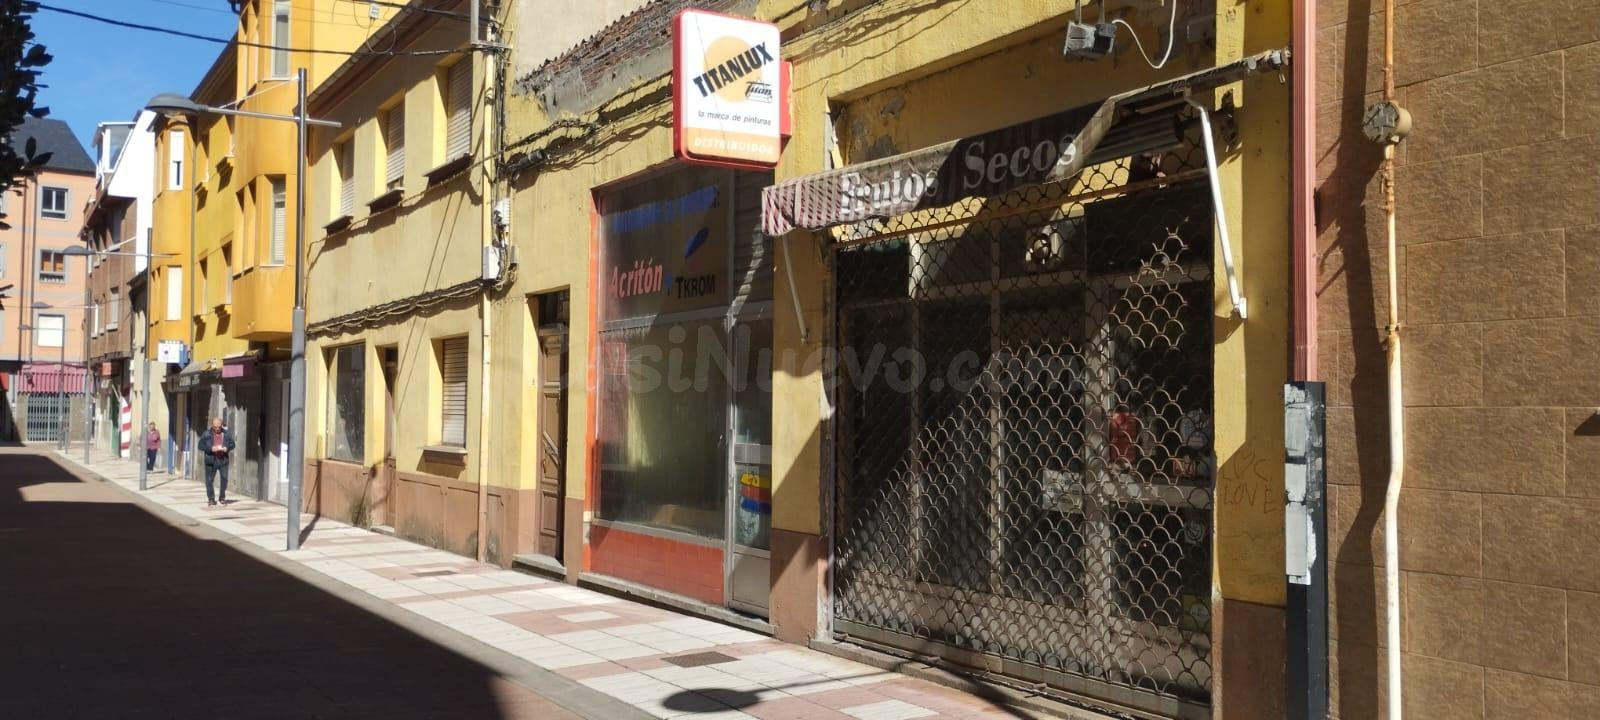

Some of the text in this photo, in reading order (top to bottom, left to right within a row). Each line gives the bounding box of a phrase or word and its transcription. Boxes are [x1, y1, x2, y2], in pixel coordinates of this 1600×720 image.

[693, 42, 774, 97] TITANLUX
[707, 111, 730, 121] marca
[732, 113, 742, 122] de
[743, 116, 772, 126] pinturas
[962, 134, 1077, 190] Secos
[609, 258, 716, 299] Acritón TKROM
